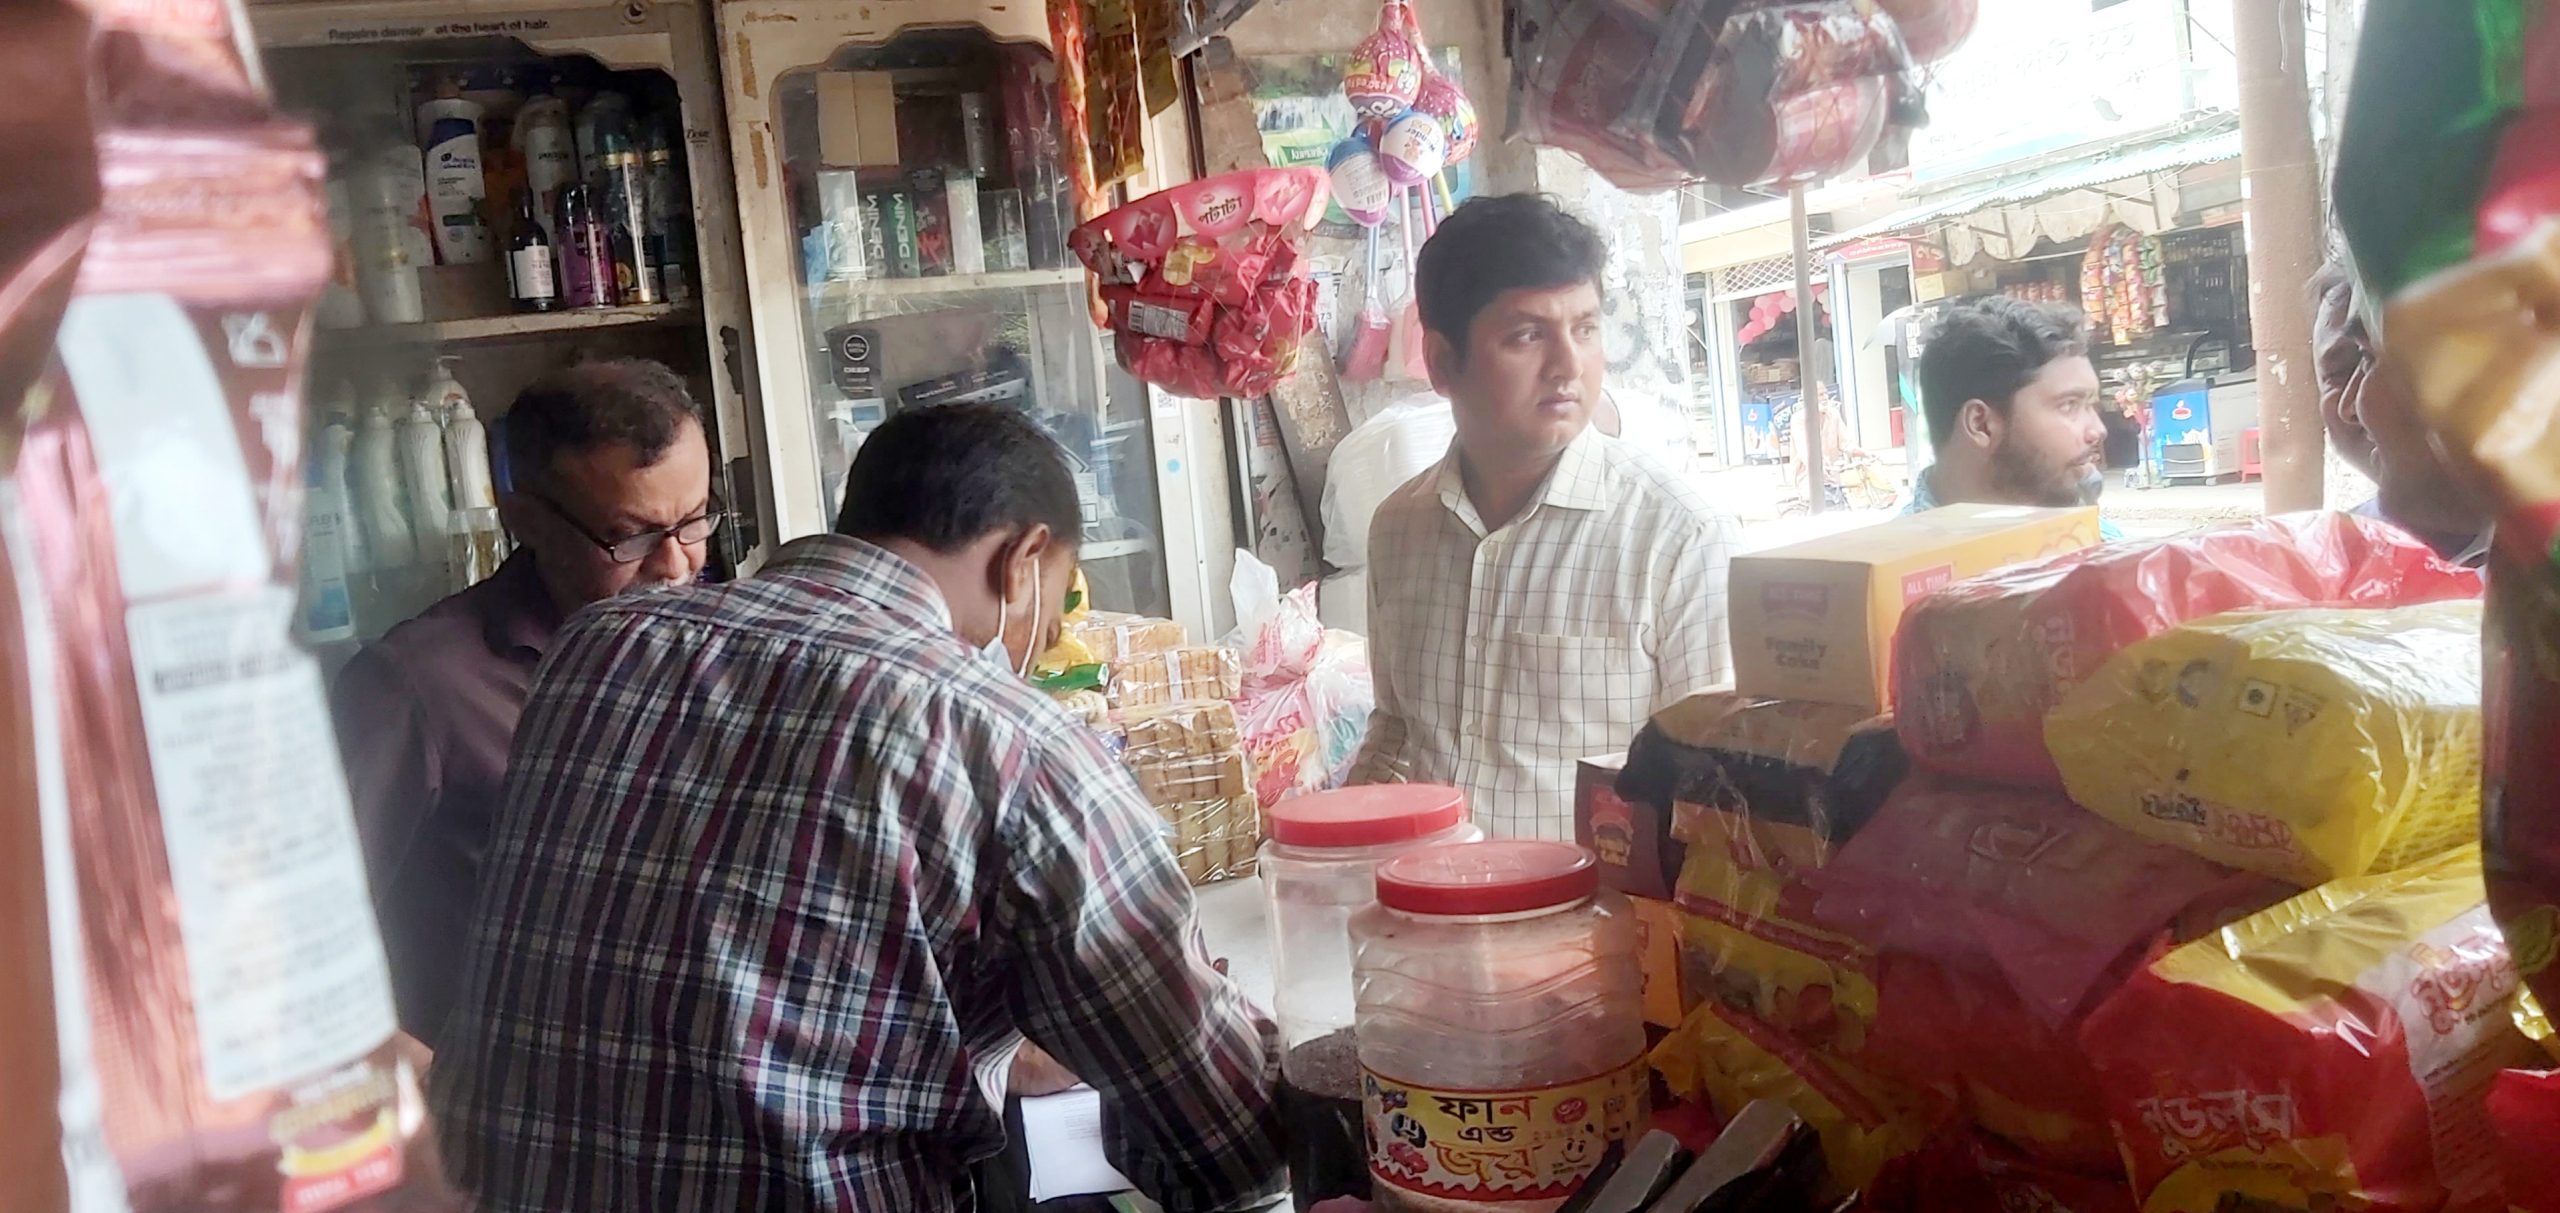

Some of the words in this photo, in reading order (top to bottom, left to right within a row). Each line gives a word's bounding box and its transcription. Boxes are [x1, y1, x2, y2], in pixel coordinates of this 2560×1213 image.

[866, 194, 885, 260] DENIM
[892, 192, 911, 259] DENIM
[1906, 581, 1922, 596] ALL
[1926, 573, 1949, 591] TIME
[1432, 1095, 1539, 1124] ফান
[1457, 1126, 1519, 1143] এন্ড
